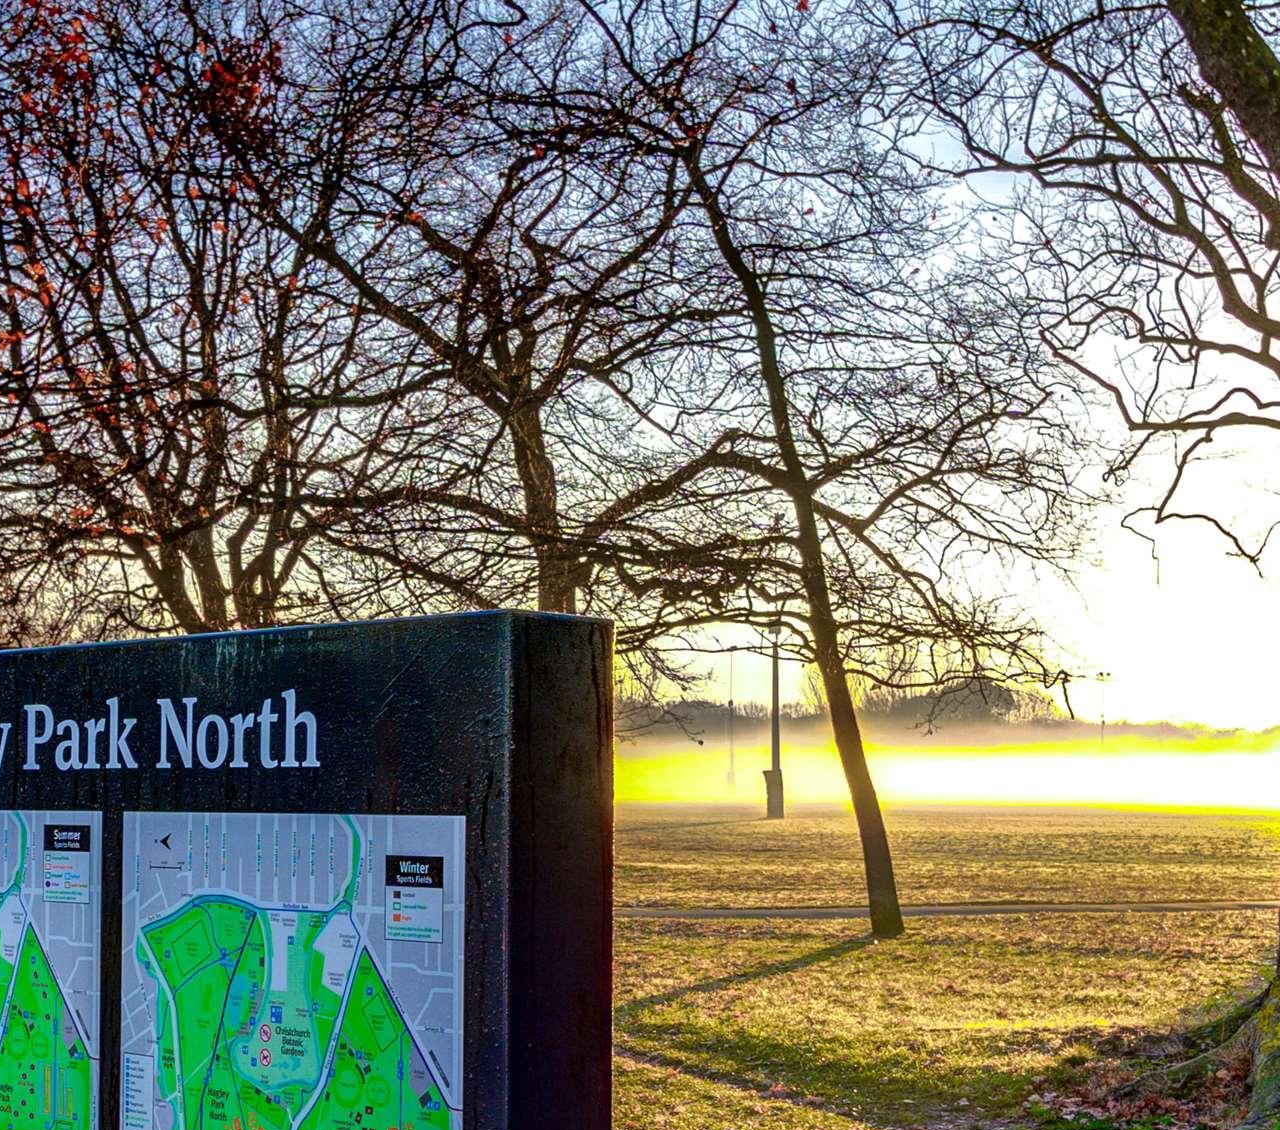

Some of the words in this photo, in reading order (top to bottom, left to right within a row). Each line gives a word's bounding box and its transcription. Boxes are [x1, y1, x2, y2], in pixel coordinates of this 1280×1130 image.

[23, 697, 138, 770] Park
[156, 687, 321, 769] North
[53, 829, 80, 841] Summer
[399, 860, 429, 874] Winter
[396, 874, 414, 884] Sports
[415, 875, 432, 884] Fields
[275, 1026, 311, 1039] Christchurch
[282, 1036, 303, 1047] Botanic
[281, 1046, 304, 1057] Gardens
[207, 1087, 229, 1101] Hagley
[210, 1099, 224, 1109] Park
[209, 1111, 227, 1121] North
